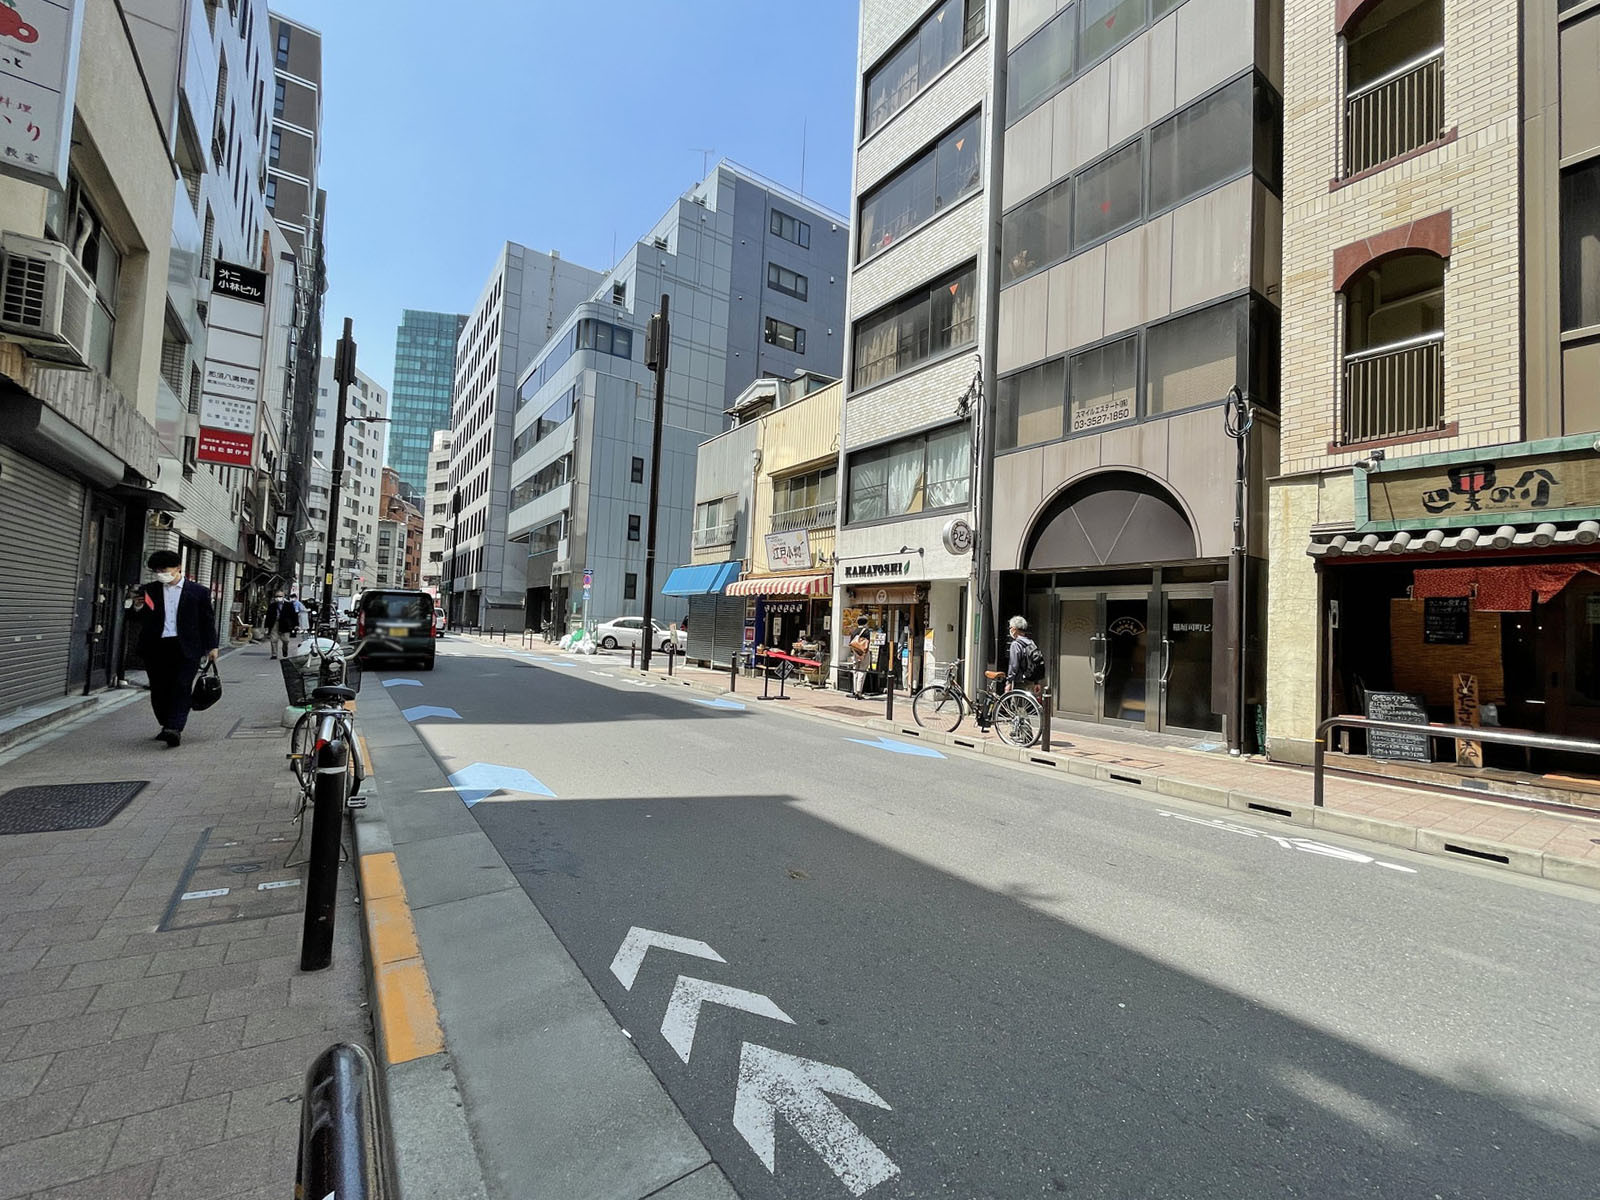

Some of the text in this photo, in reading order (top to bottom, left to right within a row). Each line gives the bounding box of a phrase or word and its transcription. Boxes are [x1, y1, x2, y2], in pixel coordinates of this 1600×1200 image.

[218, 279, 261, 297] 小林ビル
[1073, 408, 1130, 431] 03-3527-1850
[844, 562, 903, 577] KAMAYOSHI
